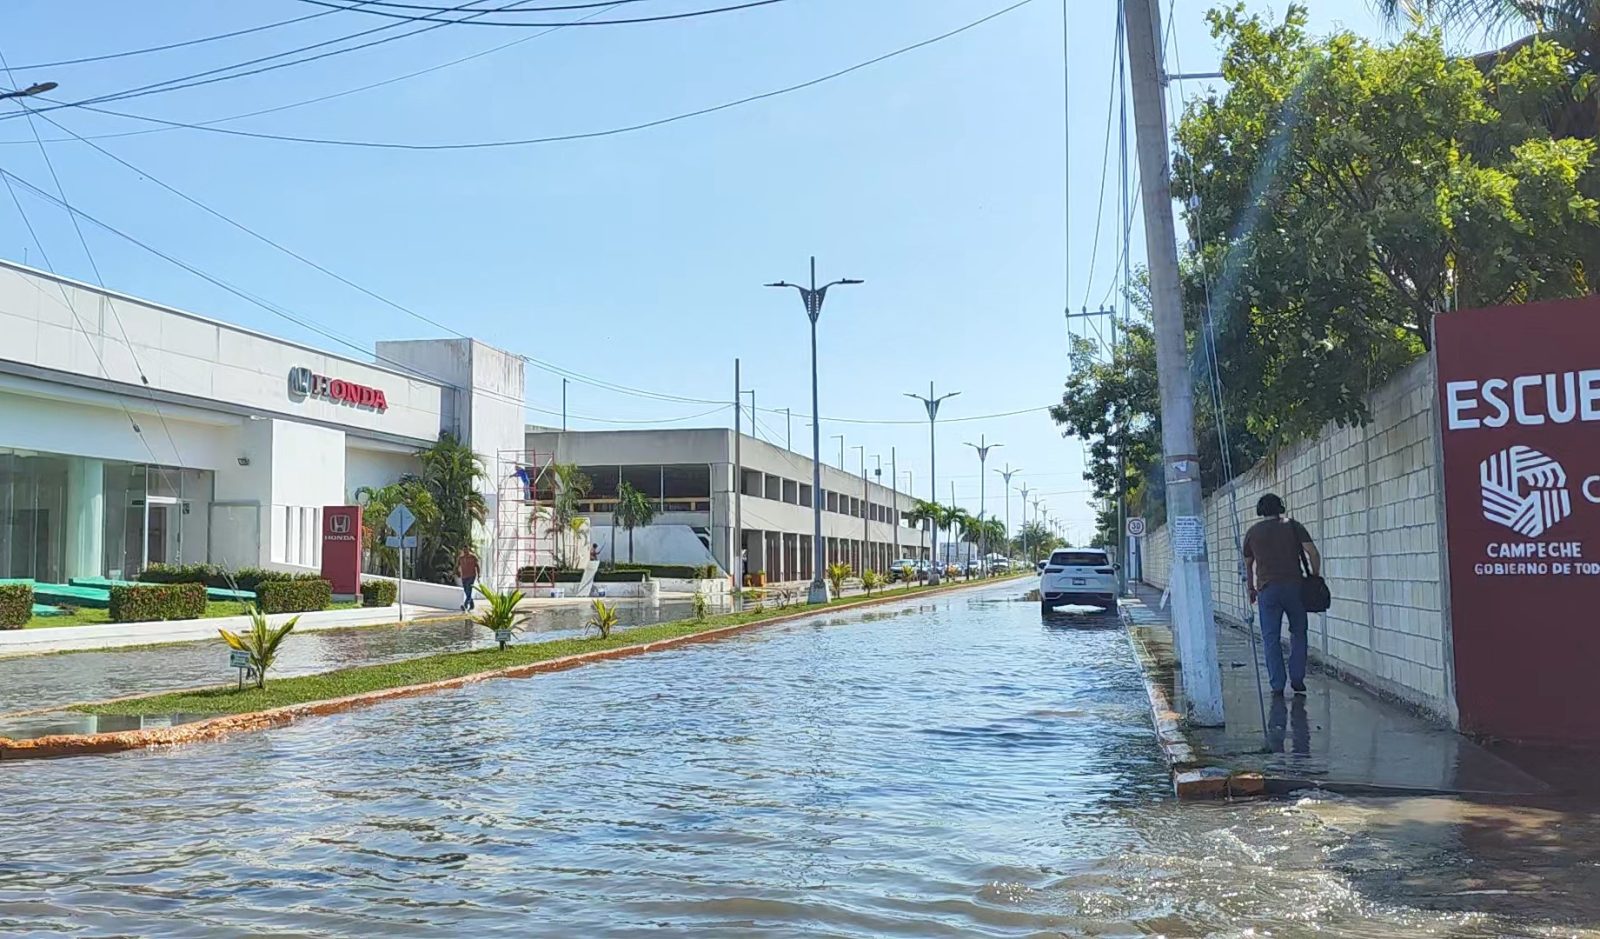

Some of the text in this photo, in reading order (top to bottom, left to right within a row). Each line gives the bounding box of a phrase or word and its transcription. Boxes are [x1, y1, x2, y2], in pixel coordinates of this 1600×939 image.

[311, 374, 388, 409] HONDA
[1446, 369, 1600, 430] ESCUE
[1486, 542, 1582, 558] CAMPECHE
[1474, 562, 1548, 575] GOBIERNO
[1552, 562, 1571, 575] DE
